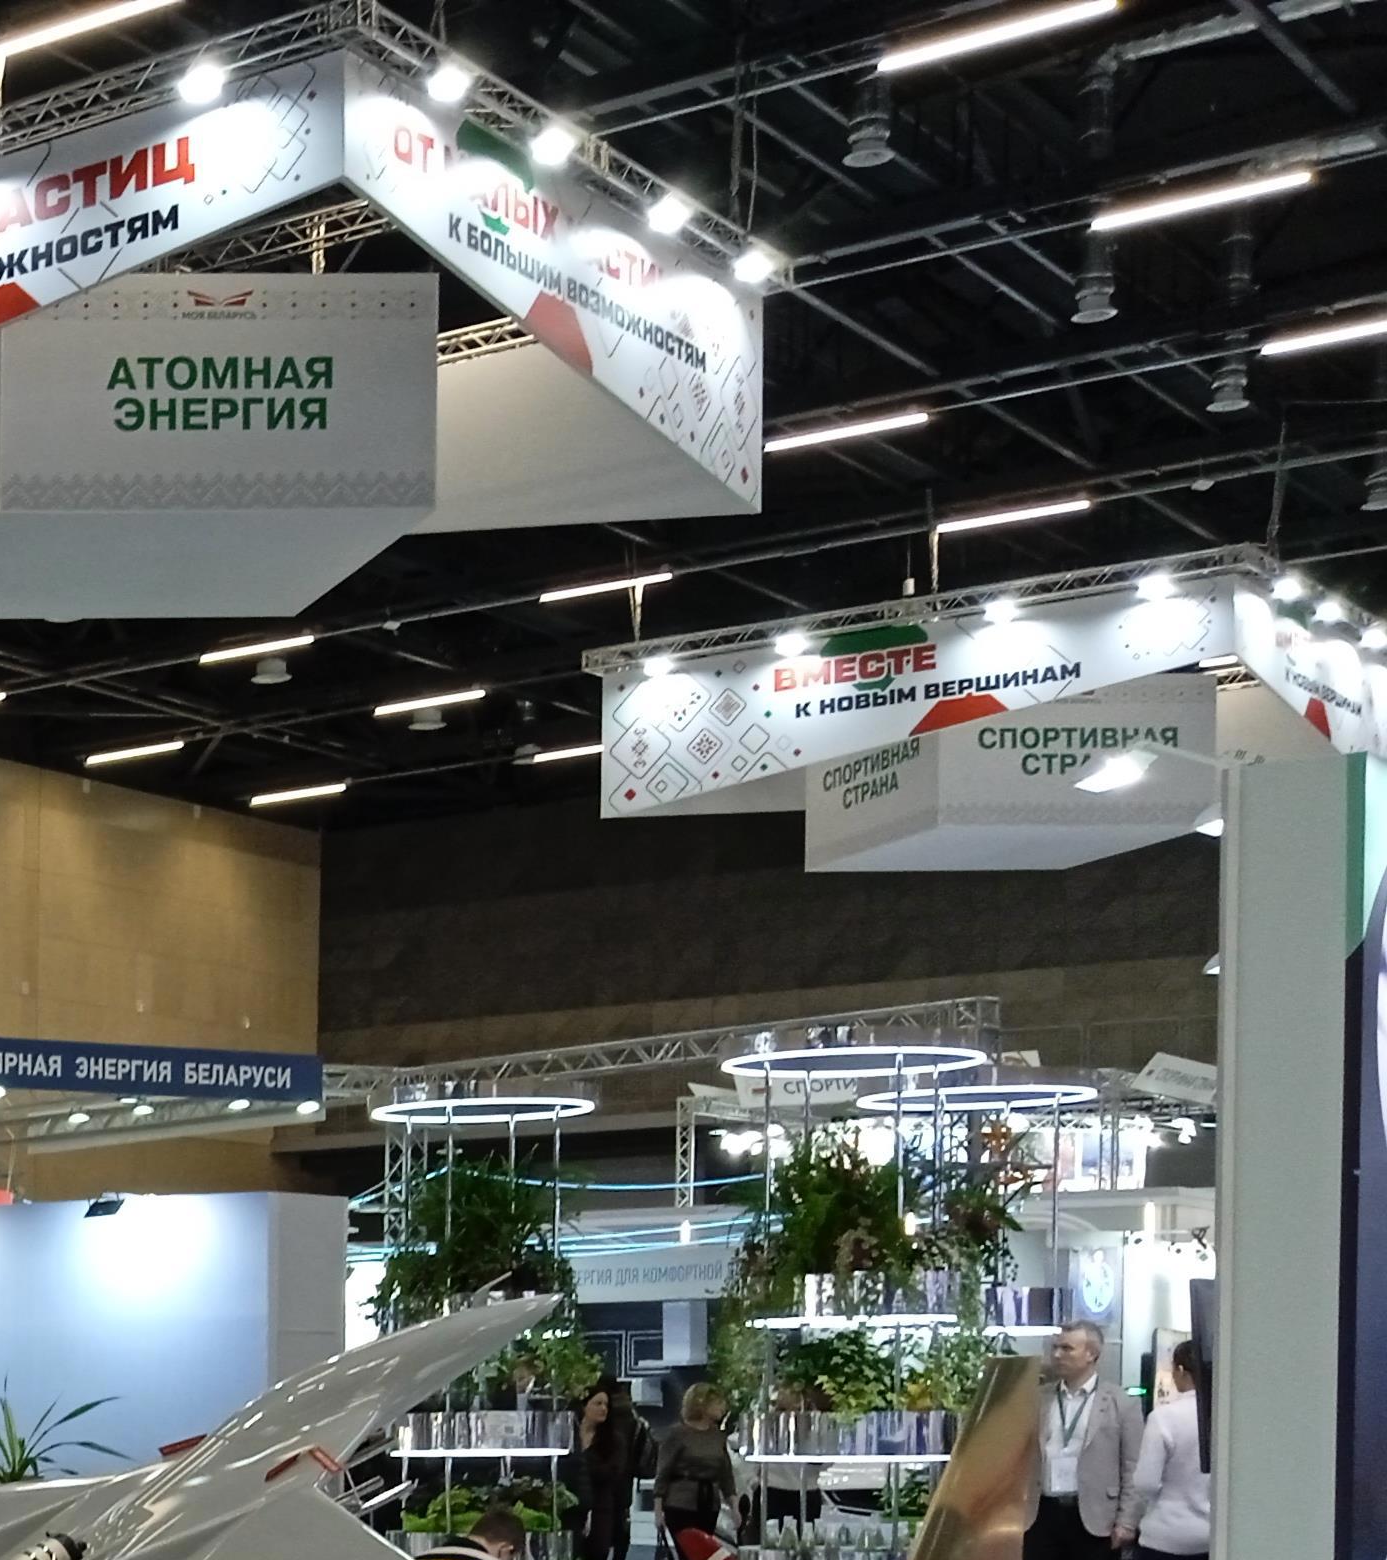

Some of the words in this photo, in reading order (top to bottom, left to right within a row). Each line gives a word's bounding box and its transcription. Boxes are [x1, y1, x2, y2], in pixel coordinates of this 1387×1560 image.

[447, 213, 462, 243] К
[467, 227, 563, 295] БОЛЬШИМ
[566, 278, 707, 373] ВОЗМОЖНОСТЯМ
[106, 356, 333, 391] АТОМНАЯ
[113, 397, 328, 431] ЭНЕРГИЯ
[773, 643, 937, 693] ВМЕСТЕ
[795, 703, 812, 719] К
[819, 684, 917, 714] НОВЫМ
[924, 663, 1082, 700] ВЕРШИНАМ
[822, 736, 921, 792] СПОРТИВНАЯ
[842, 771, 899, 809] СТРАНА
[75, 1055, 172, 1082] ЭНЕРГИЯ
[184, 1061, 292, 1090] БЕЛАРУСИ
[782, 1077, 858, 1096] СПОРТИ
[576, 1269, 612, 1287] ЕРГИЯ
[615, 1268, 639, 1286] ДЛЯ
[642, 1261, 723, 1284] КОМФОРТНОЙ
